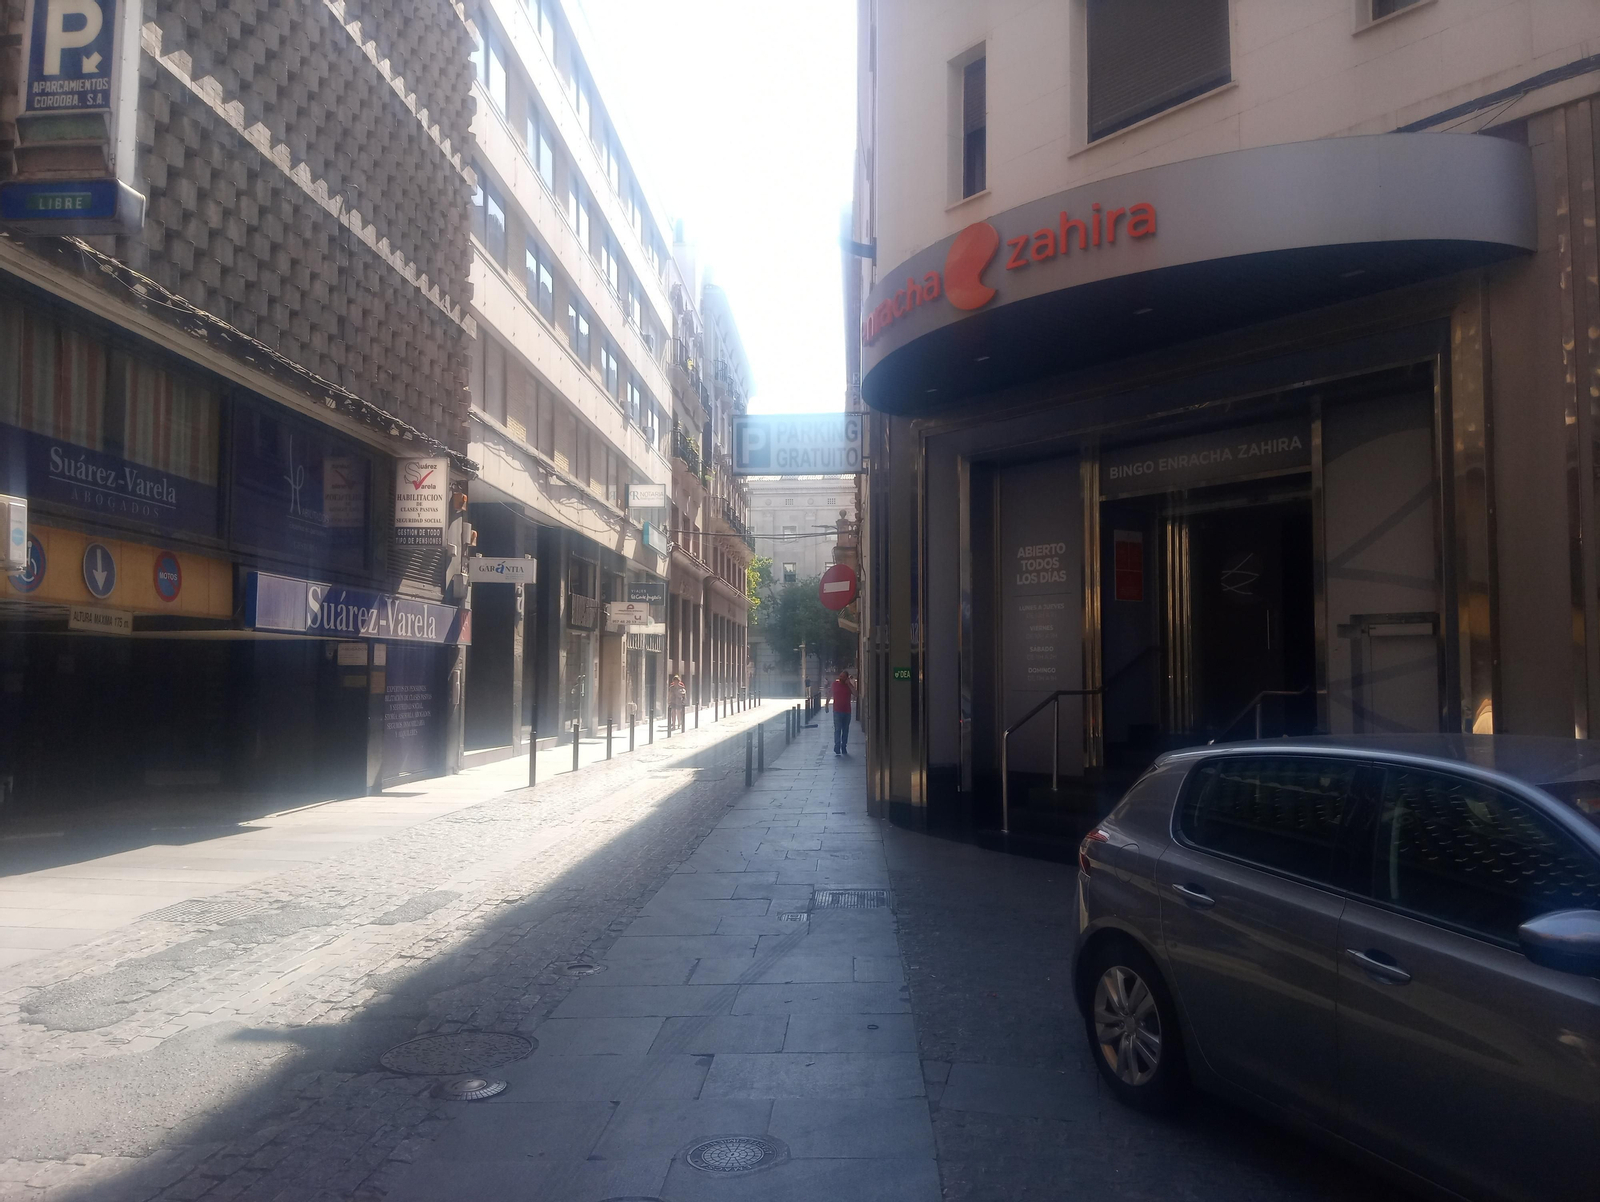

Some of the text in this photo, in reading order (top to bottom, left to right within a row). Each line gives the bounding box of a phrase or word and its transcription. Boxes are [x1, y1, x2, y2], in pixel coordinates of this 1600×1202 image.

[43, 0, 103, 75] P
[32, 78, 109, 94] APARCAMIENTOS
[87, 93, 105, 105] S.A.
[39, 197, 83, 209] LIBRE
[1005, 202, 1156, 270] zahira
[776, 420, 858, 443] PARKING
[776, 447, 858, 468] GRATUITO
[1109, 435, 1302, 479] BINGO ENRACHA ZAHIRA
[50, 446, 176, 503] Suárez-Varela
[71, 488, 159, 518] ABOGADOS
[419, 528, 426, 536] DE
[427, 528, 441, 536] TODO
[395, 537, 442, 545] TIPO DE PENSIONES
[1017, 542, 1066, 558] ABIERTO
[1021, 557, 1059, 571] TODOS
[159, 572, 178, 581] MOTOS
[1016, 569, 1067, 585] LOS DÍAS
[73, 611, 92, 623] ALTURA
[307, 585, 436, 639] Suárez-Varela
[1029, 645, 1054, 653] SÁBADO
[901, 670, 911, 679] DEA
